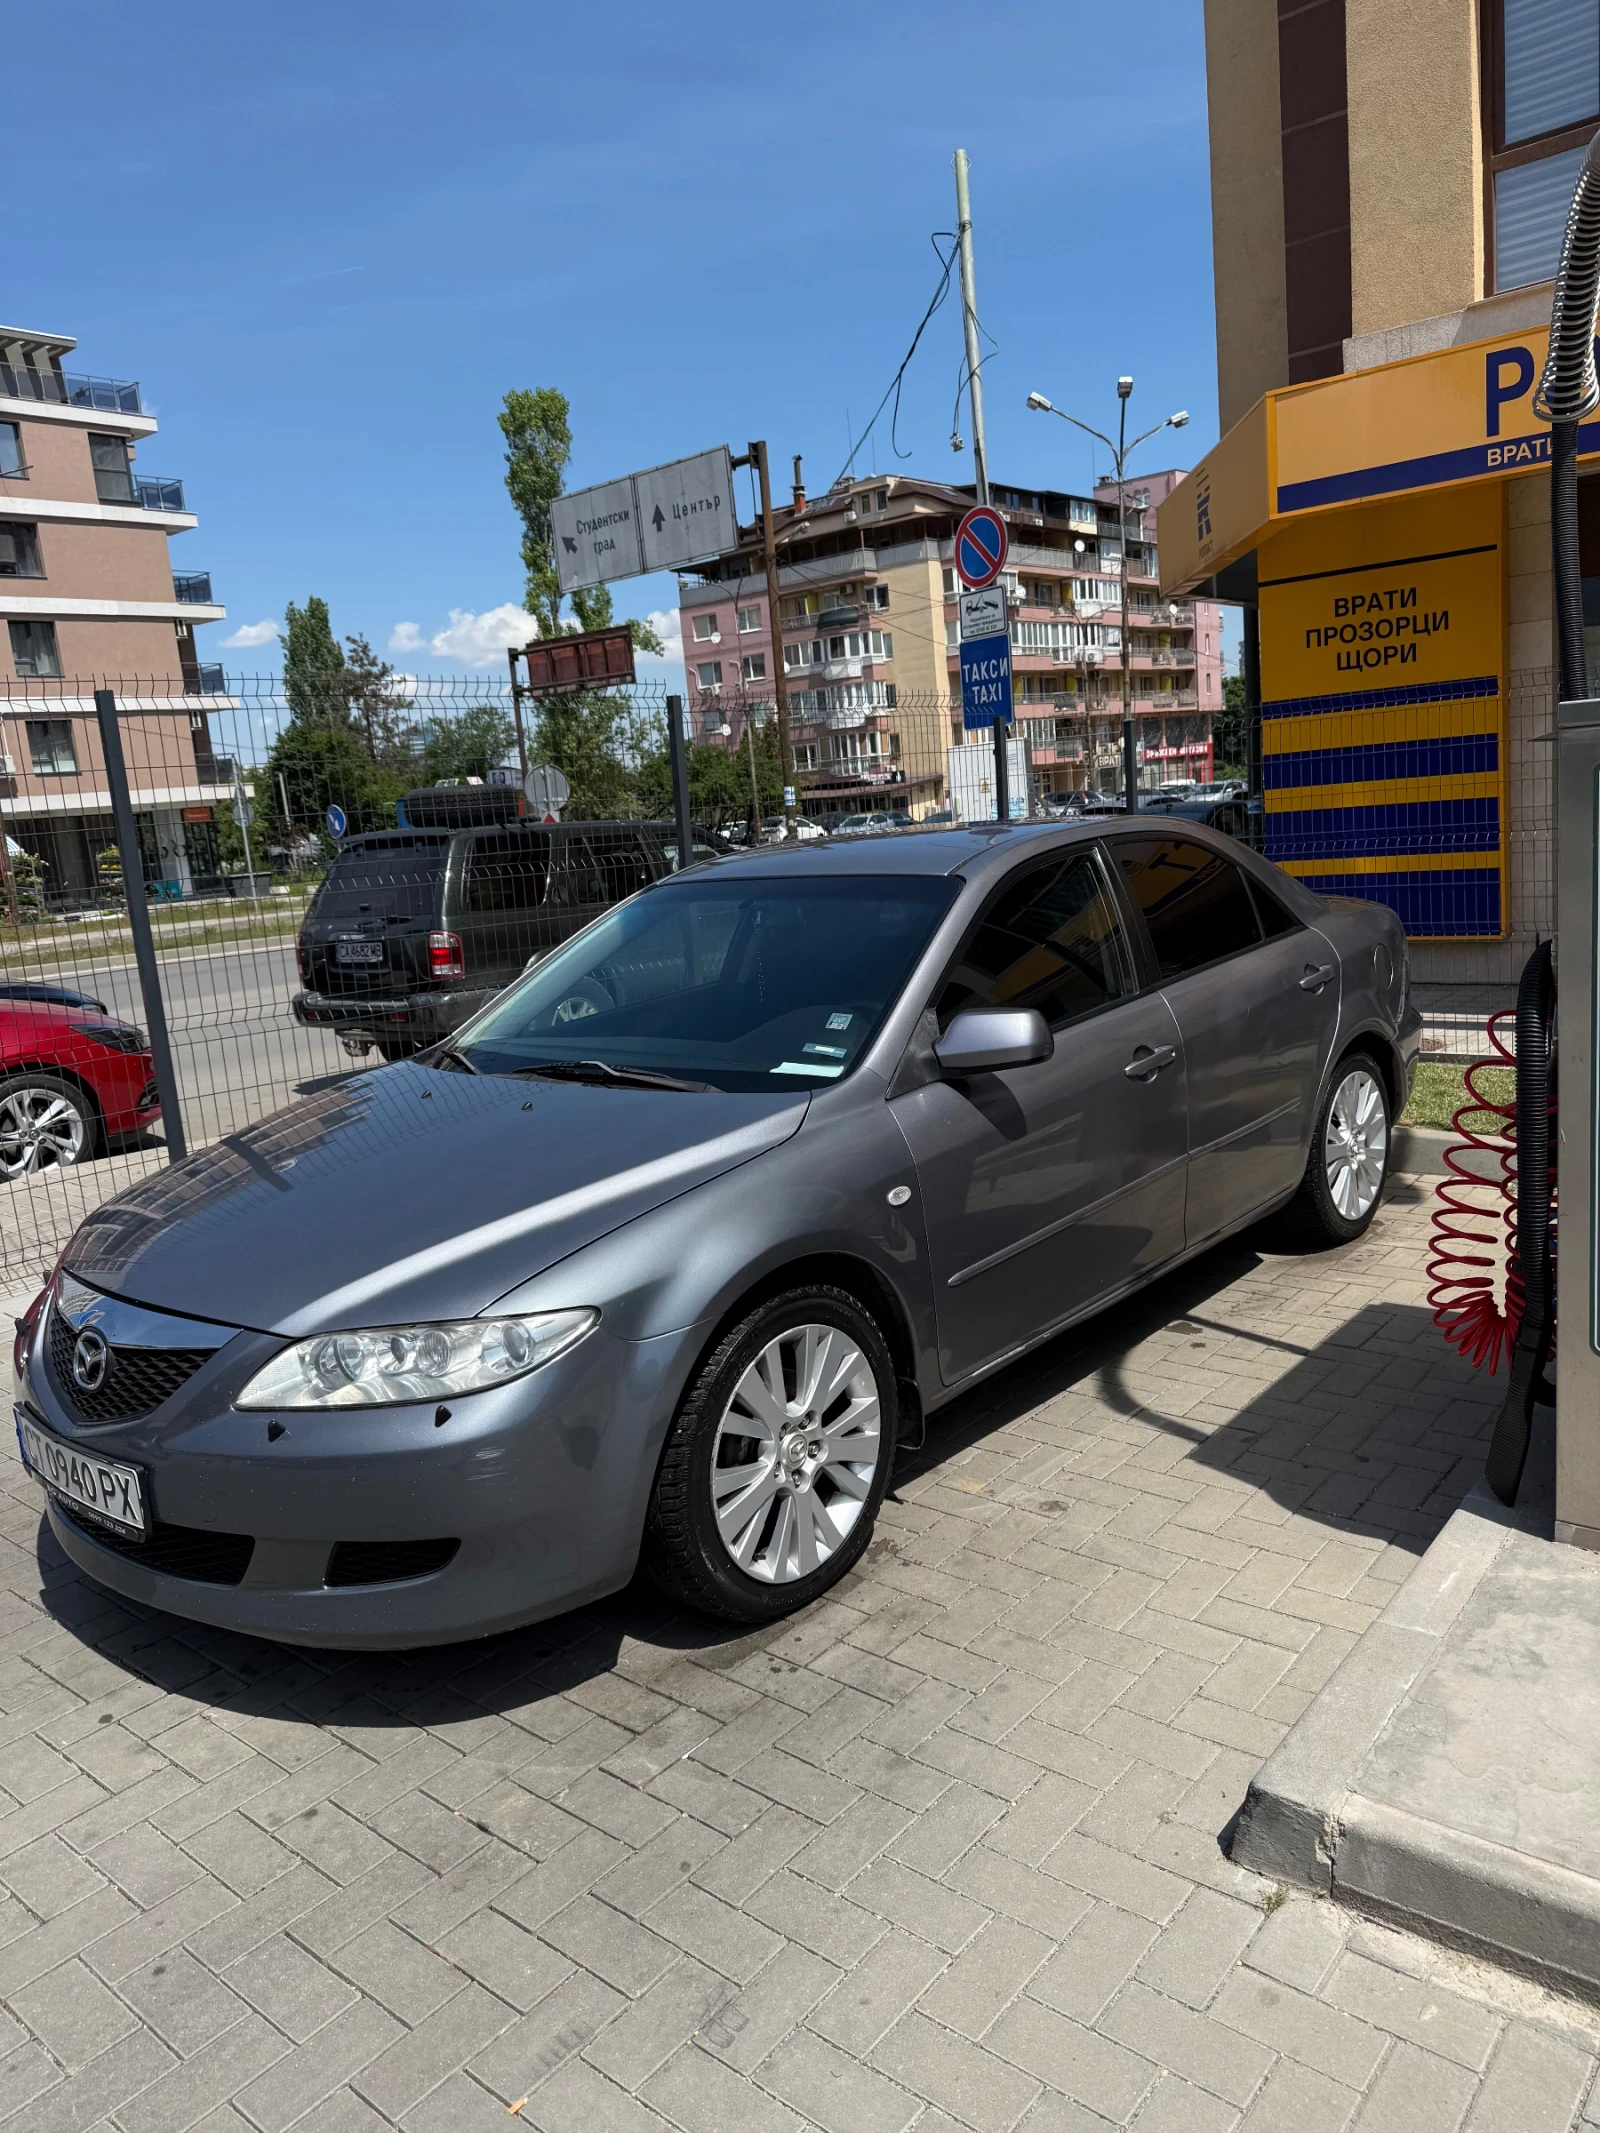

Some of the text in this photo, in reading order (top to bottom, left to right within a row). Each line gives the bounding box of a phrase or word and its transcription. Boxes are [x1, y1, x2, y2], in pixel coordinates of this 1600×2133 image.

[672, 495, 721, 520] Център
[576, 509, 630, 535] Студентски
[593, 538, 616, 556] град
[1334, 587, 1417, 618] ВРАТИ
[1306, 610, 1449, 648] ПРОЗОРЦИ
[962, 657, 1008, 683] ТАКСИ
[1336, 642, 1417, 672] ЩОРИ
[971, 682, 1003, 705] TAXI
[58, 1493, 79, 1511] AUTO
